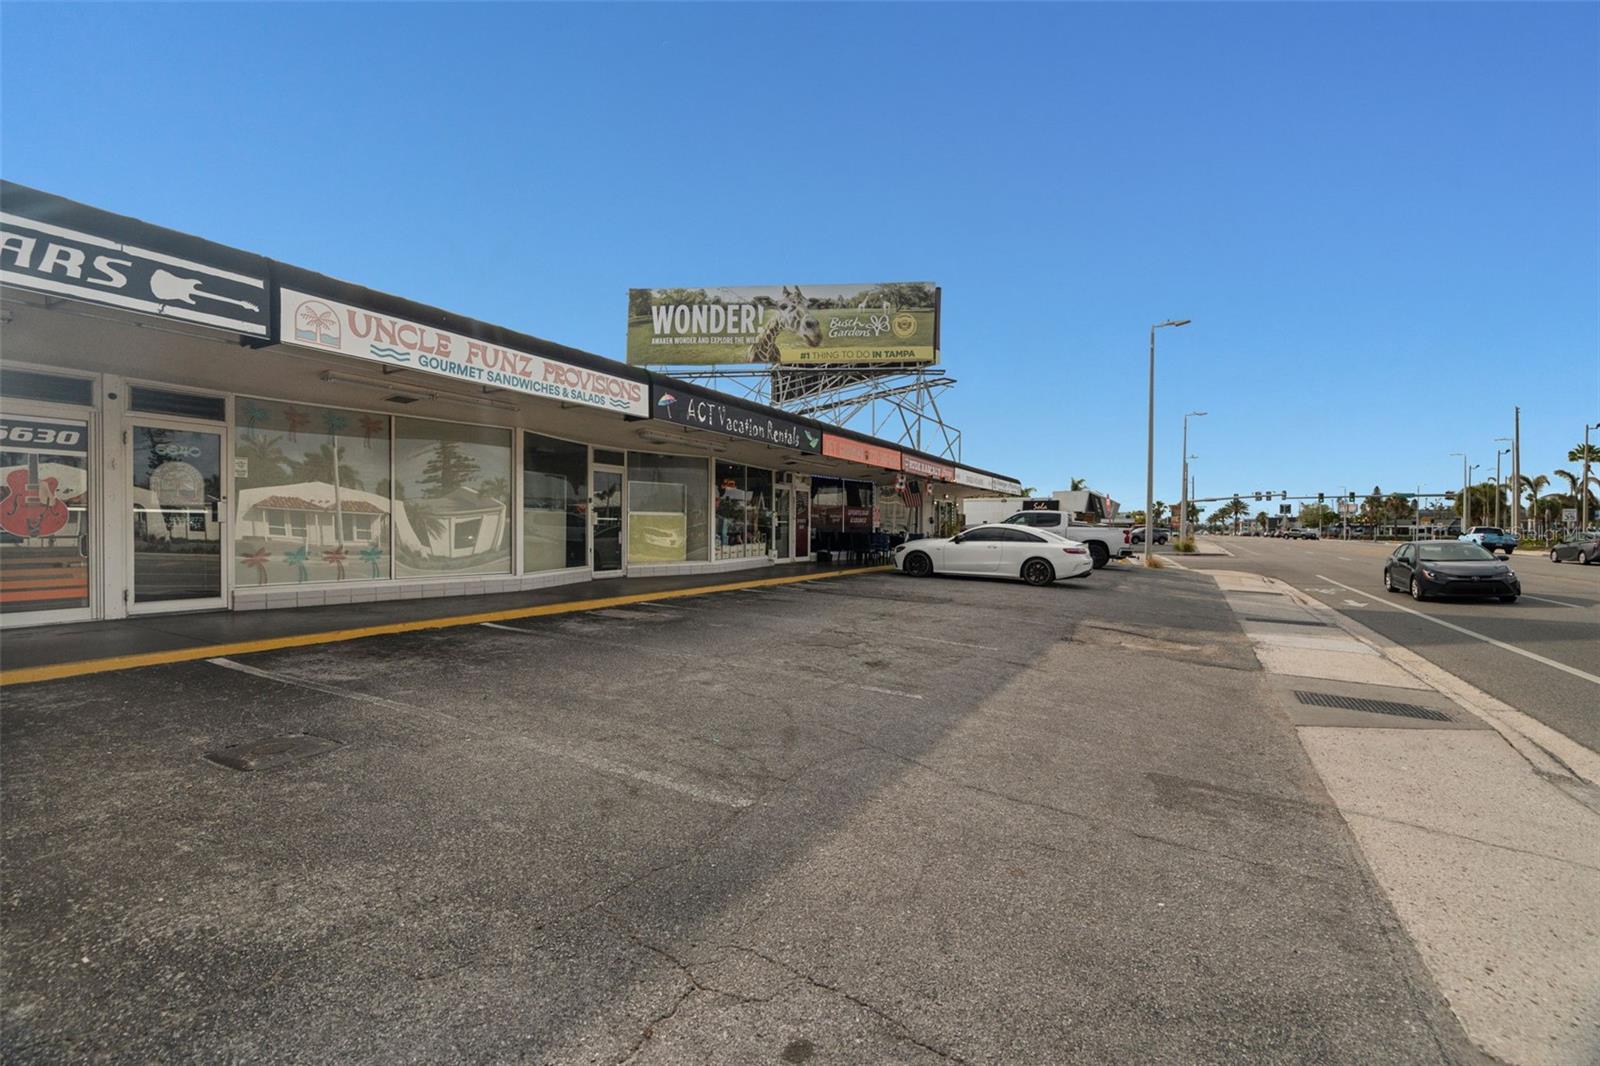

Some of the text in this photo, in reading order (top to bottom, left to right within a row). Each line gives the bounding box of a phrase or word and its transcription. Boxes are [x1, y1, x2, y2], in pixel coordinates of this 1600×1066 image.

[651, 304, 765, 335] WONDER!
[829, 316, 866, 328] Busch
[651, 337, 673, 345] AWAKEN
[674, 336, 697, 345] WONDER
[698, 336, 709, 345] AND
[710, 336, 733, 344] EXPLORE
[735, 336, 744, 344] THE
[828, 327, 871, 338] Gardens
[346, 309, 641, 402] UNCLE FUNZ PROVISIONS
[800, 352, 810, 360] #1
[811, 351, 839, 359] THING
[842, 351, 854, 359] TO
[884, 350, 916, 358] TAMPA
[418, 355, 606, 406] GOURMET SANDWICHES & SALADS
[687, 398, 800, 447] ACT Vacation Rentals
